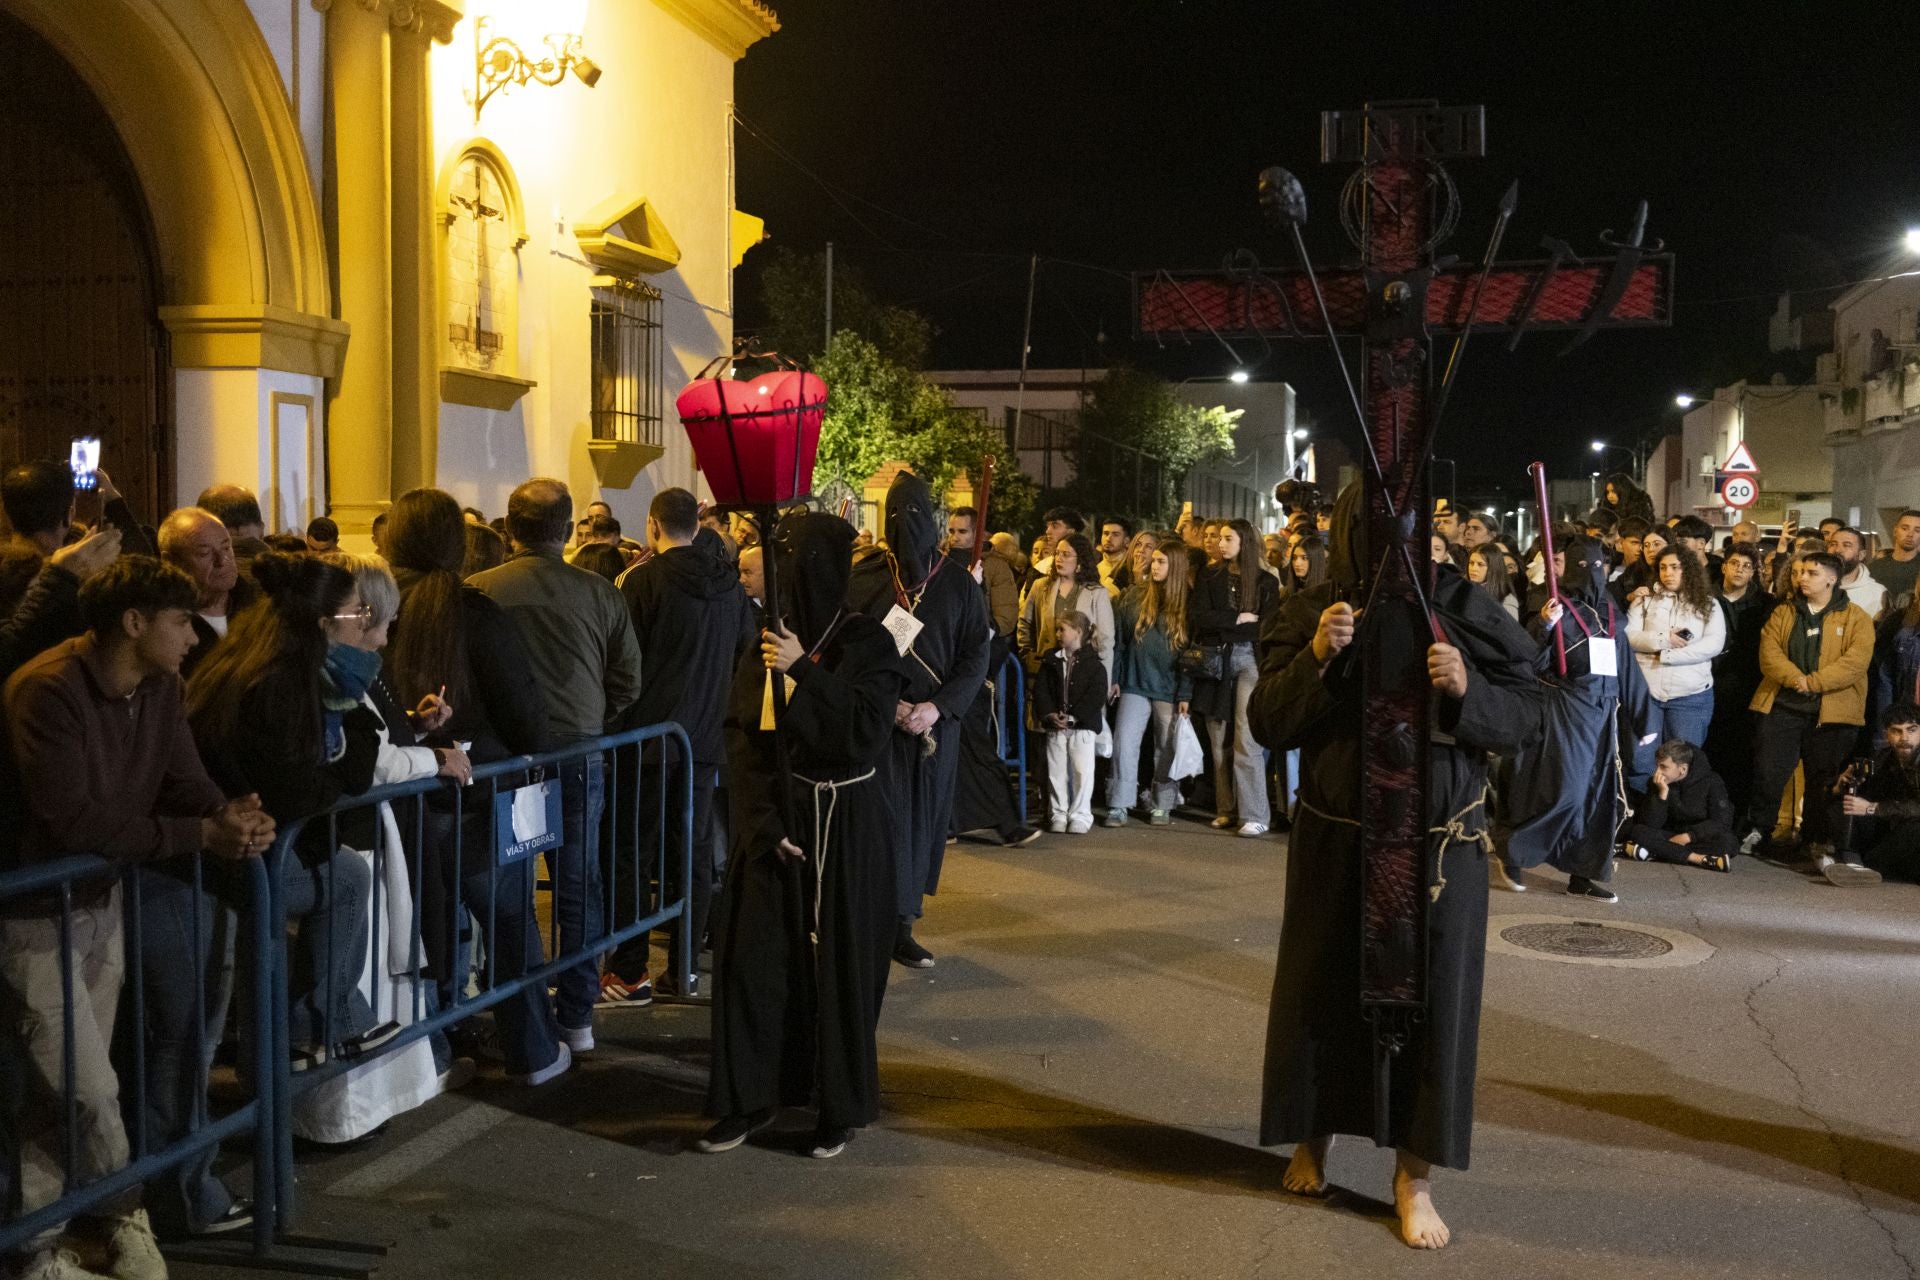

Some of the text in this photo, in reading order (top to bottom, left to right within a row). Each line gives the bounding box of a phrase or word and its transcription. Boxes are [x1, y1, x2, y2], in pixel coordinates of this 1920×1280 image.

[1729, 486, 1750, 497] 20
[525, 841, 531, 851] Y
[531, 833, 555, 848] OBRAS
